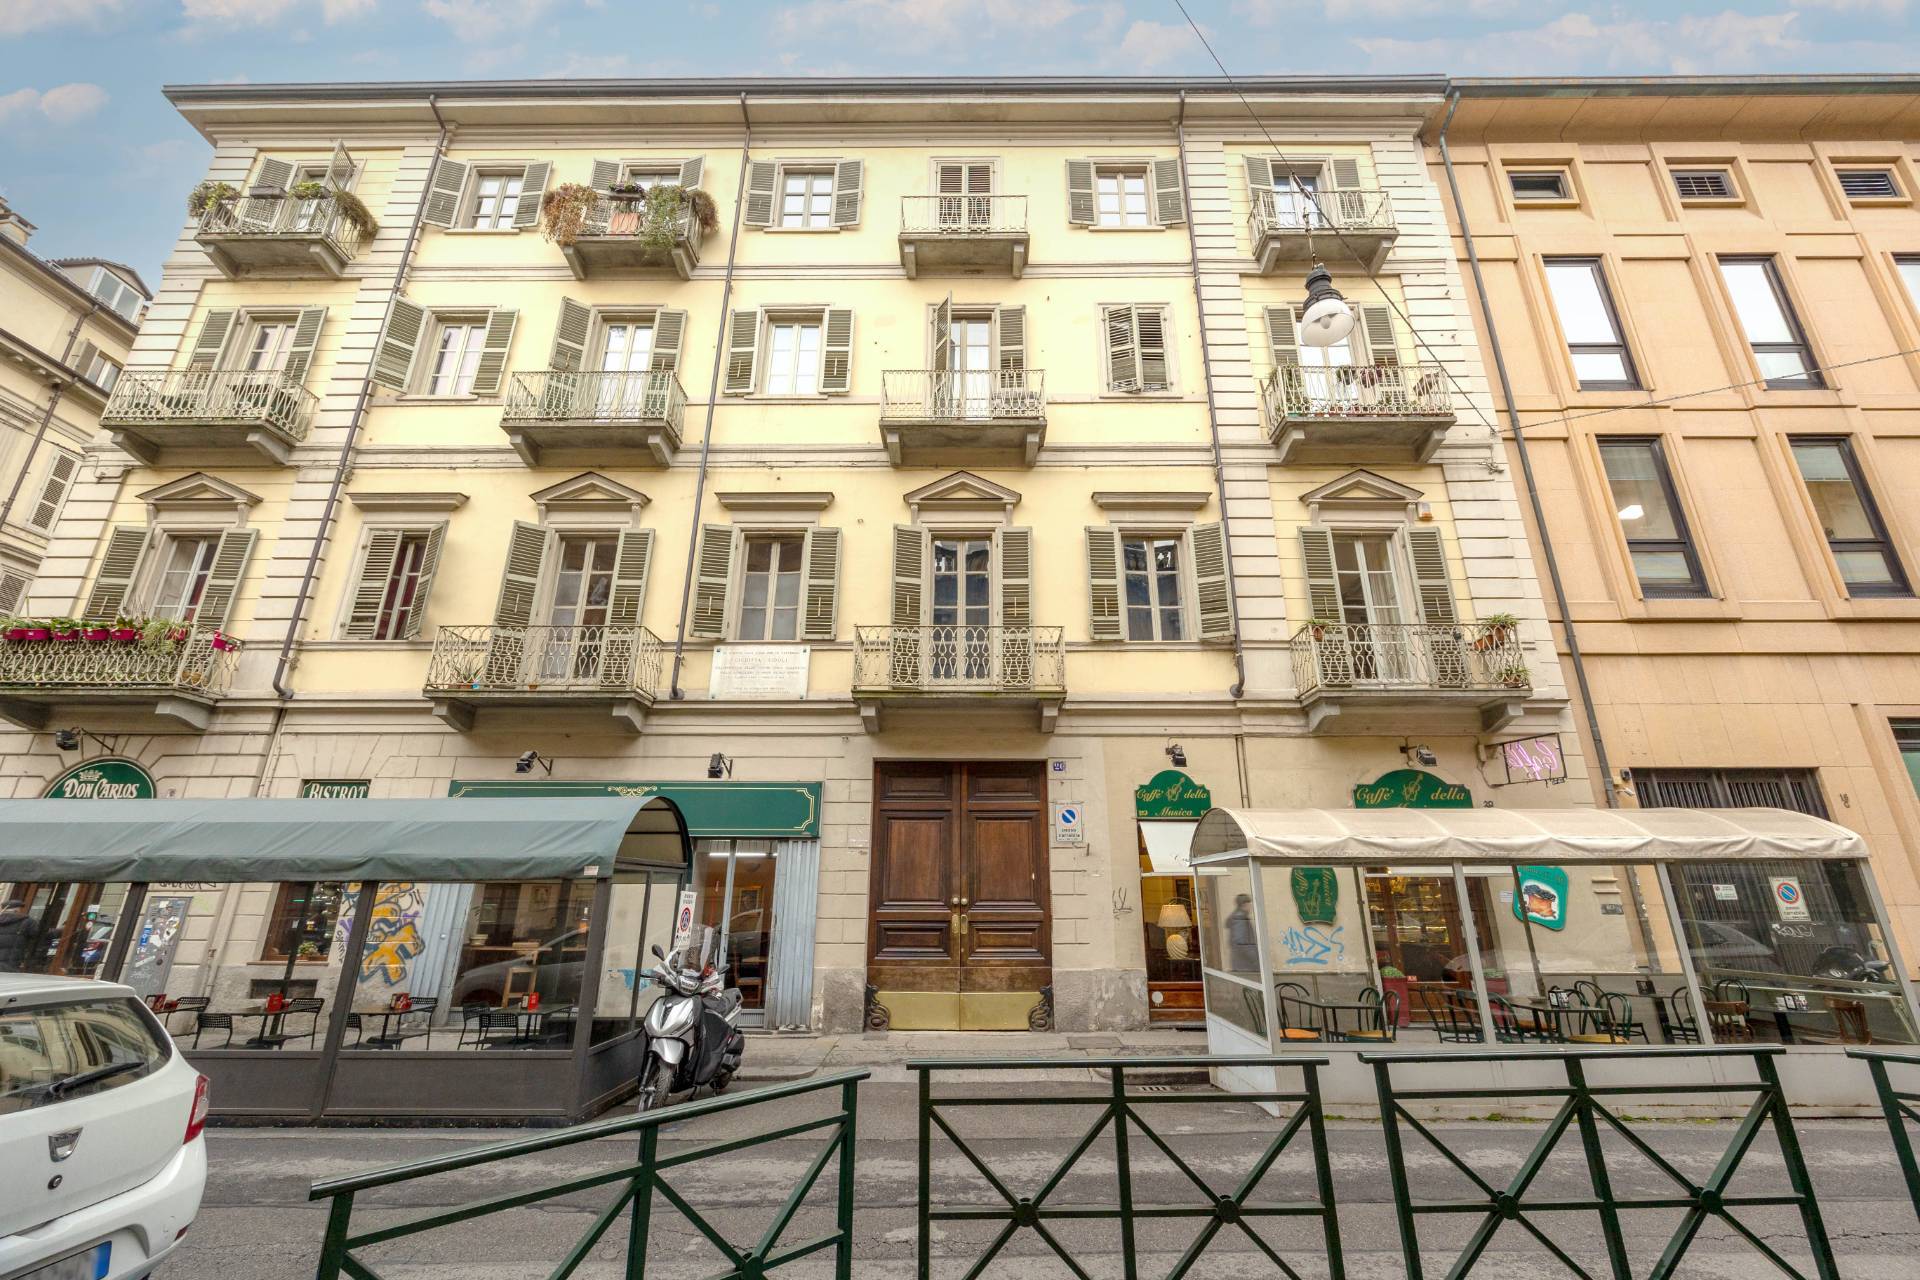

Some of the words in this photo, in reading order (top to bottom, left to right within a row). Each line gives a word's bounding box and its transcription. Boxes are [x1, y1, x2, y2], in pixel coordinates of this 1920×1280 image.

[62, 778, 95, 798] DON
[93, 778, 140, 799] CARLOS
[309, 783, 368, 799] BISTROT
[1183, 788, 1208, 799] della
[1430, 787, 1466, 801] della
[1154, 806, 1193, 817] Musica
